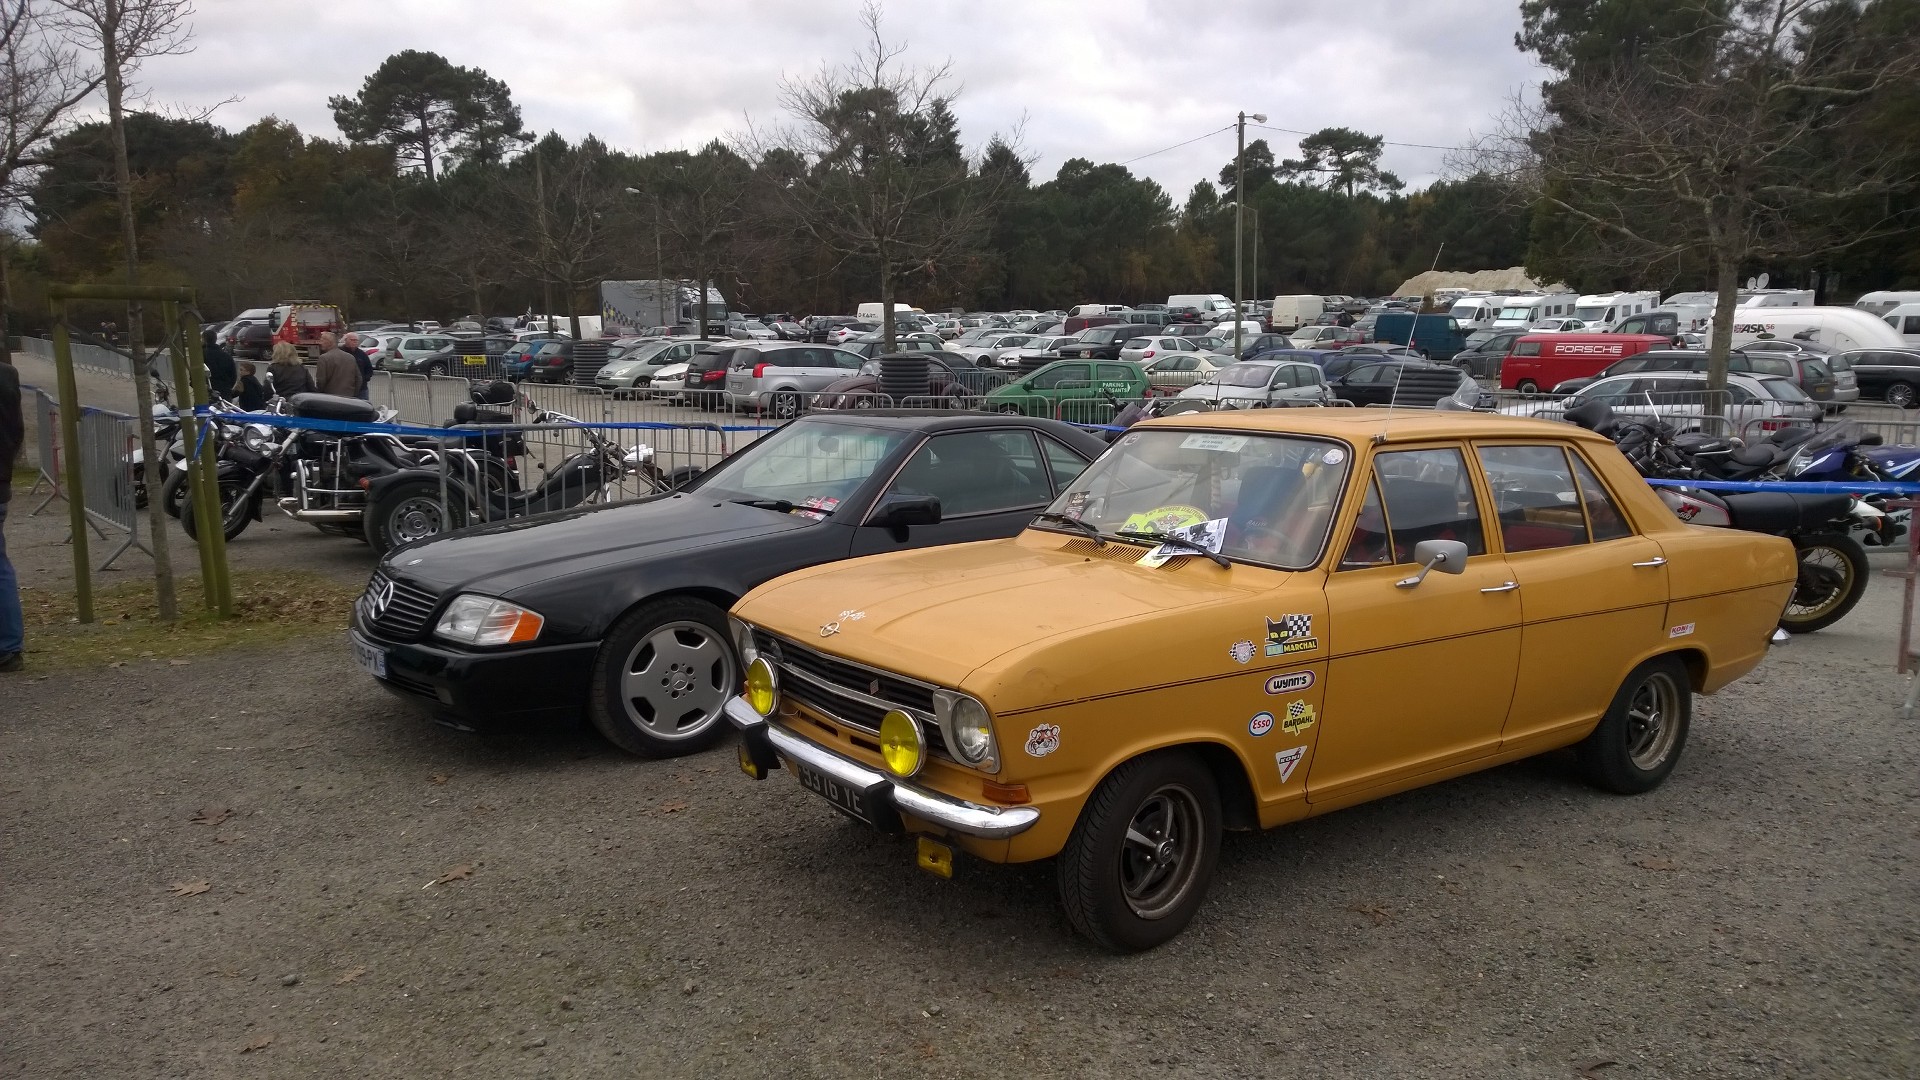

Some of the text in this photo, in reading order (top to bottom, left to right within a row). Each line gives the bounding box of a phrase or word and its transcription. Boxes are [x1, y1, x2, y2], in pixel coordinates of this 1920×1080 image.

[1741, 324, 1767, 333] ASA
[1555, 345, 1623, 354] PORSCHE
[1671, 625, 1689, 634] KONI
[1283, 641, 1316, 652] MARCHAL
[1283, 715, 1314, 729] BARDAHL
[1279, 753, 1300, 764] KONI
